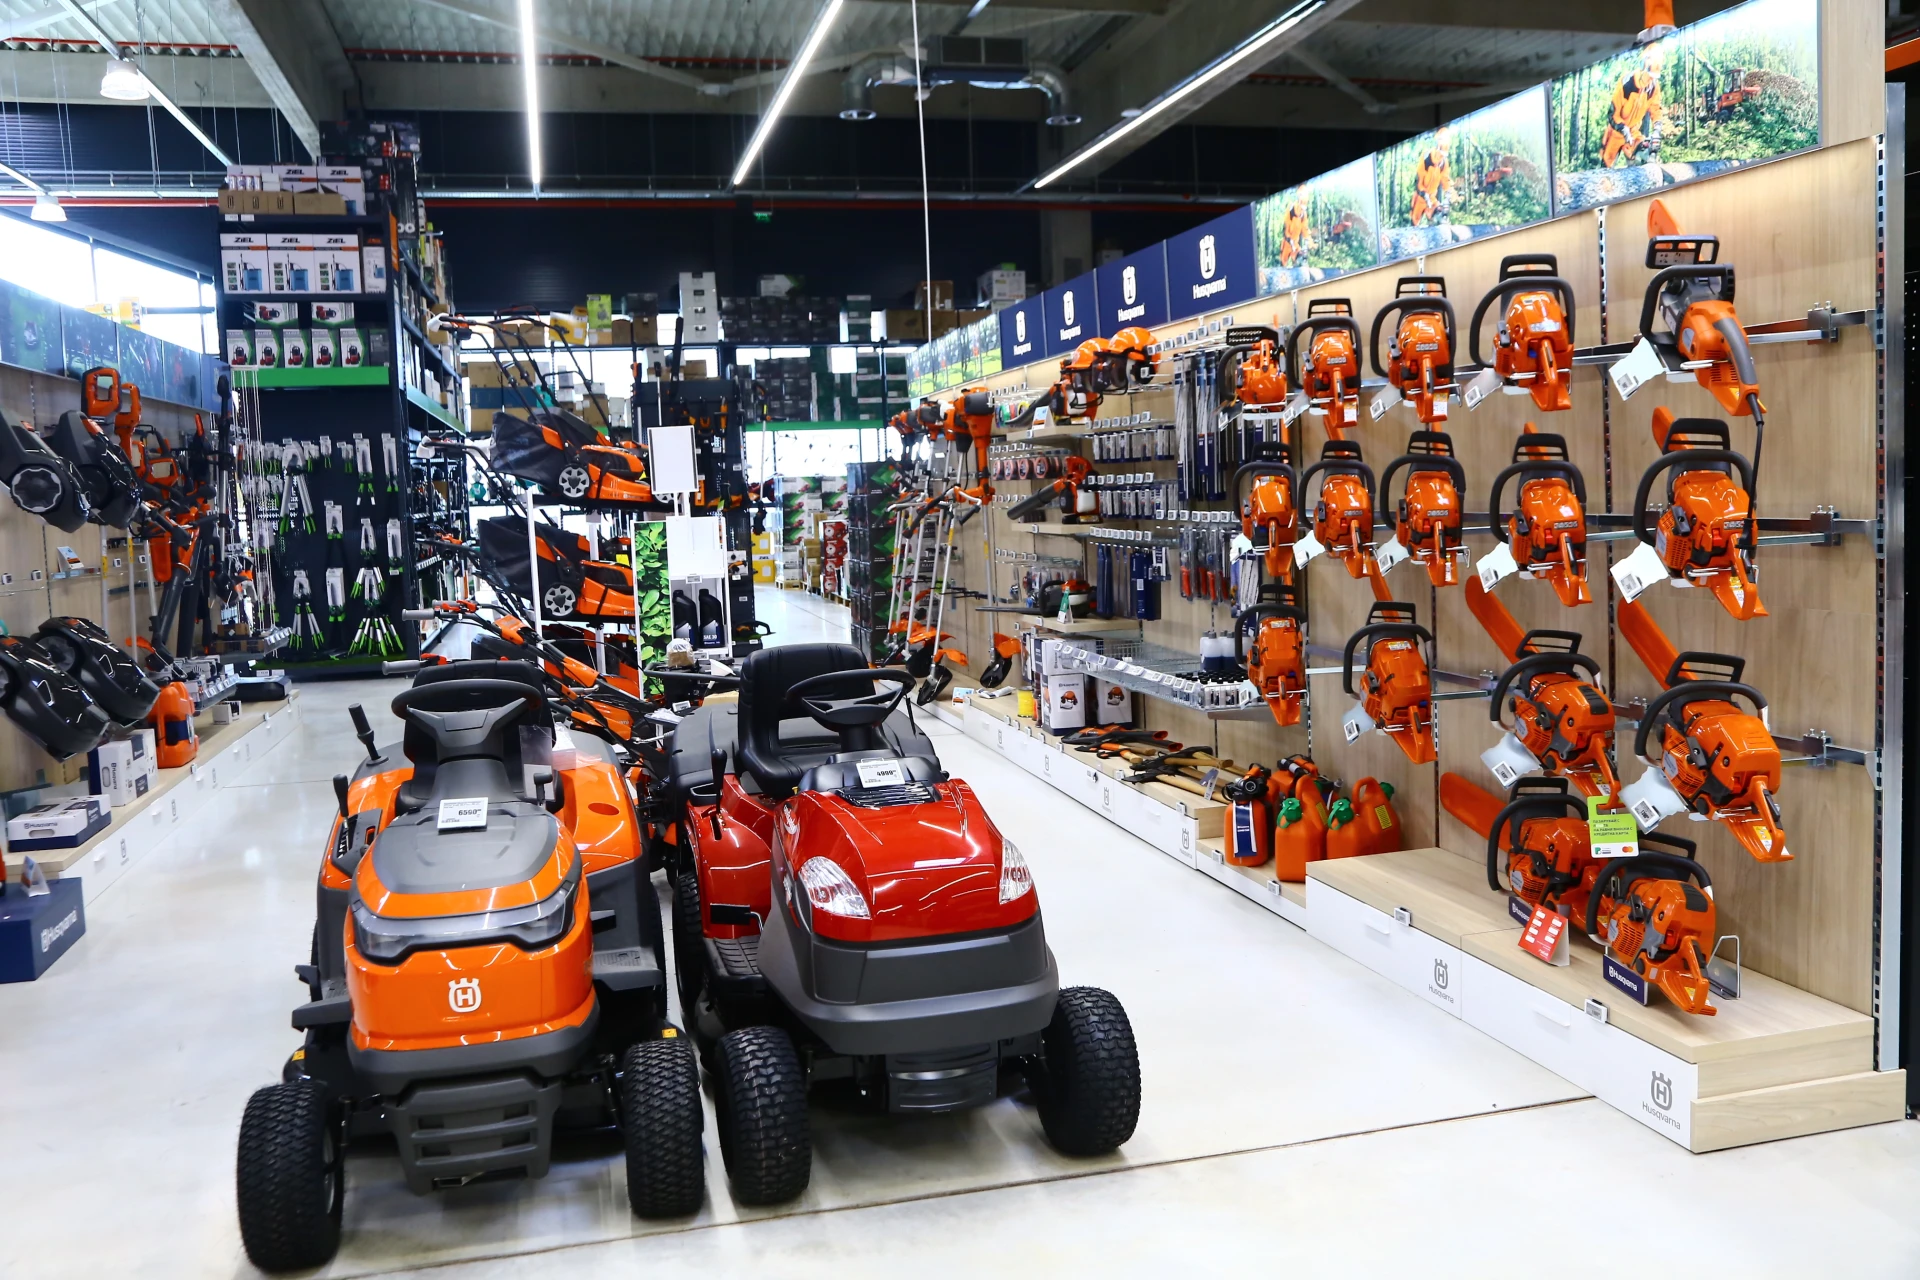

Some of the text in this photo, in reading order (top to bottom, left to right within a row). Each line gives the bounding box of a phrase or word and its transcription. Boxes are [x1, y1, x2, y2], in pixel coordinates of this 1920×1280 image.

[1192, 277, 1227, 300] Husqvarna
[1117, 303, 1145, 322] Husqvarna
[1059, 325, 1081, 341] Husqvarna
[1613, 970, 1638, 993] Husqvarna
[1428, 984, 1454, 1004] Husqvarna
[1642, 1101, 1681, 1130] Husqvarna
